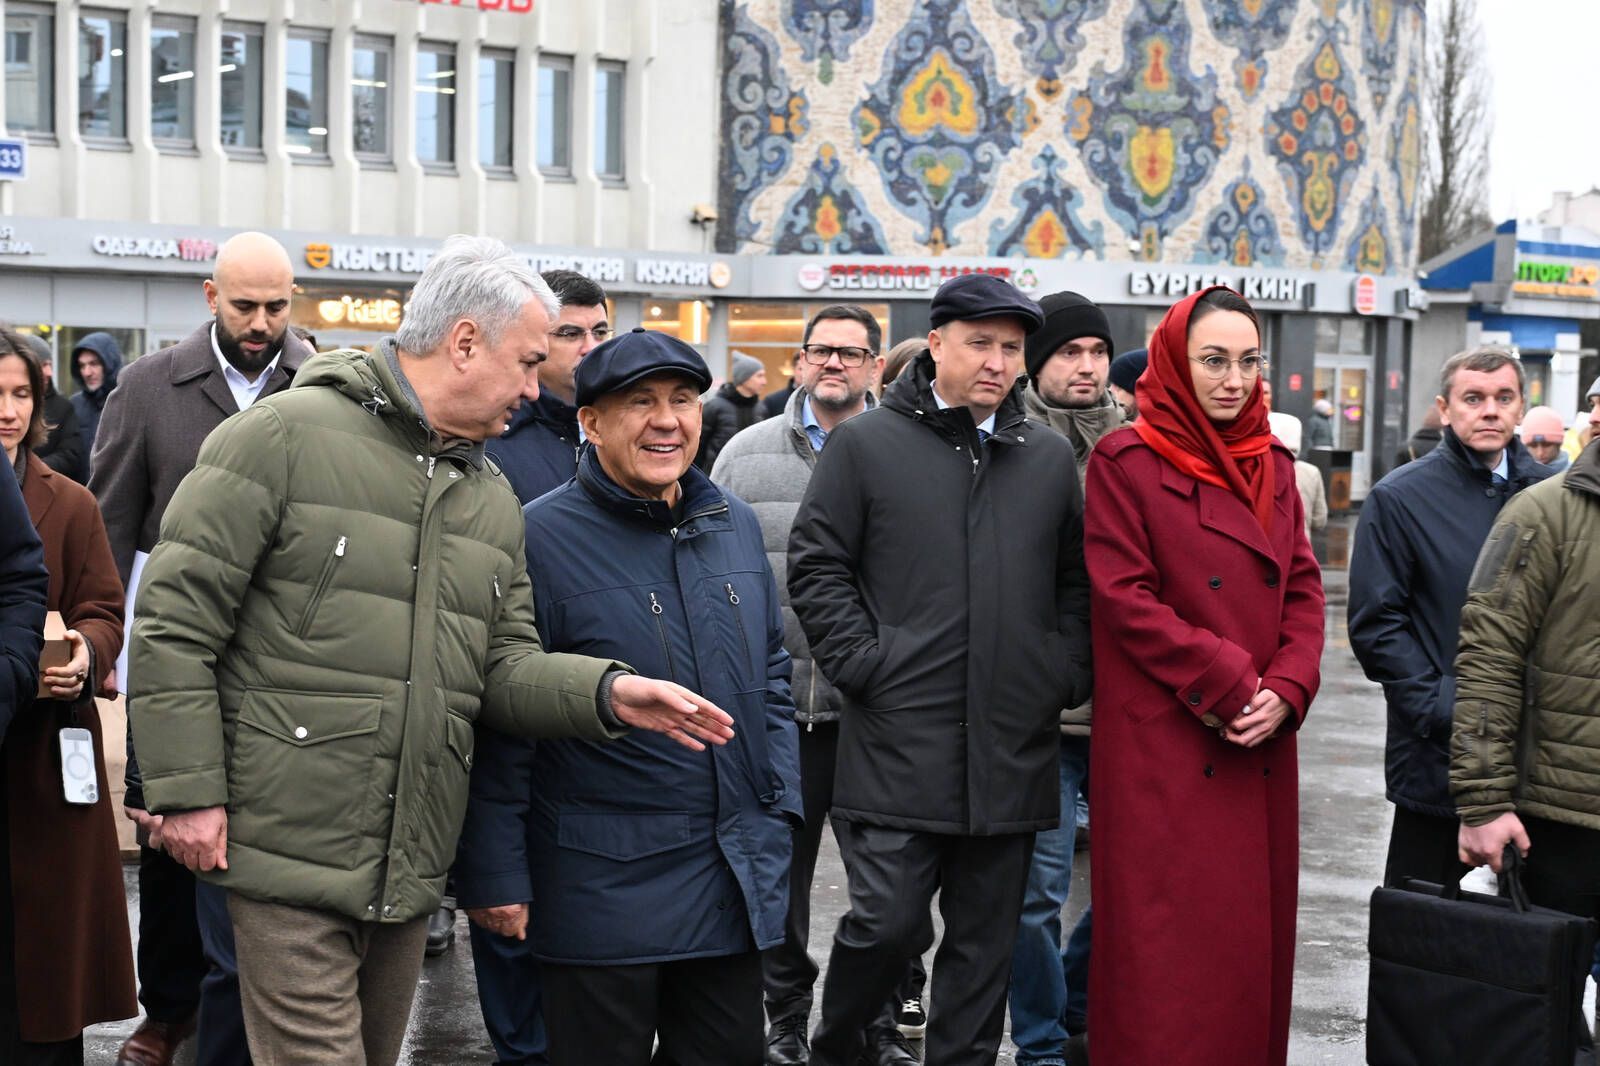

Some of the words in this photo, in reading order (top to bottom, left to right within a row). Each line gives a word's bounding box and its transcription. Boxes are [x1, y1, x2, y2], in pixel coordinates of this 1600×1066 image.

[93, 236, 180, 258] ОДЕЖДА
[637, 260, 709, 285] КУХНЯ
[830, 264, 930, 290] SECOND
